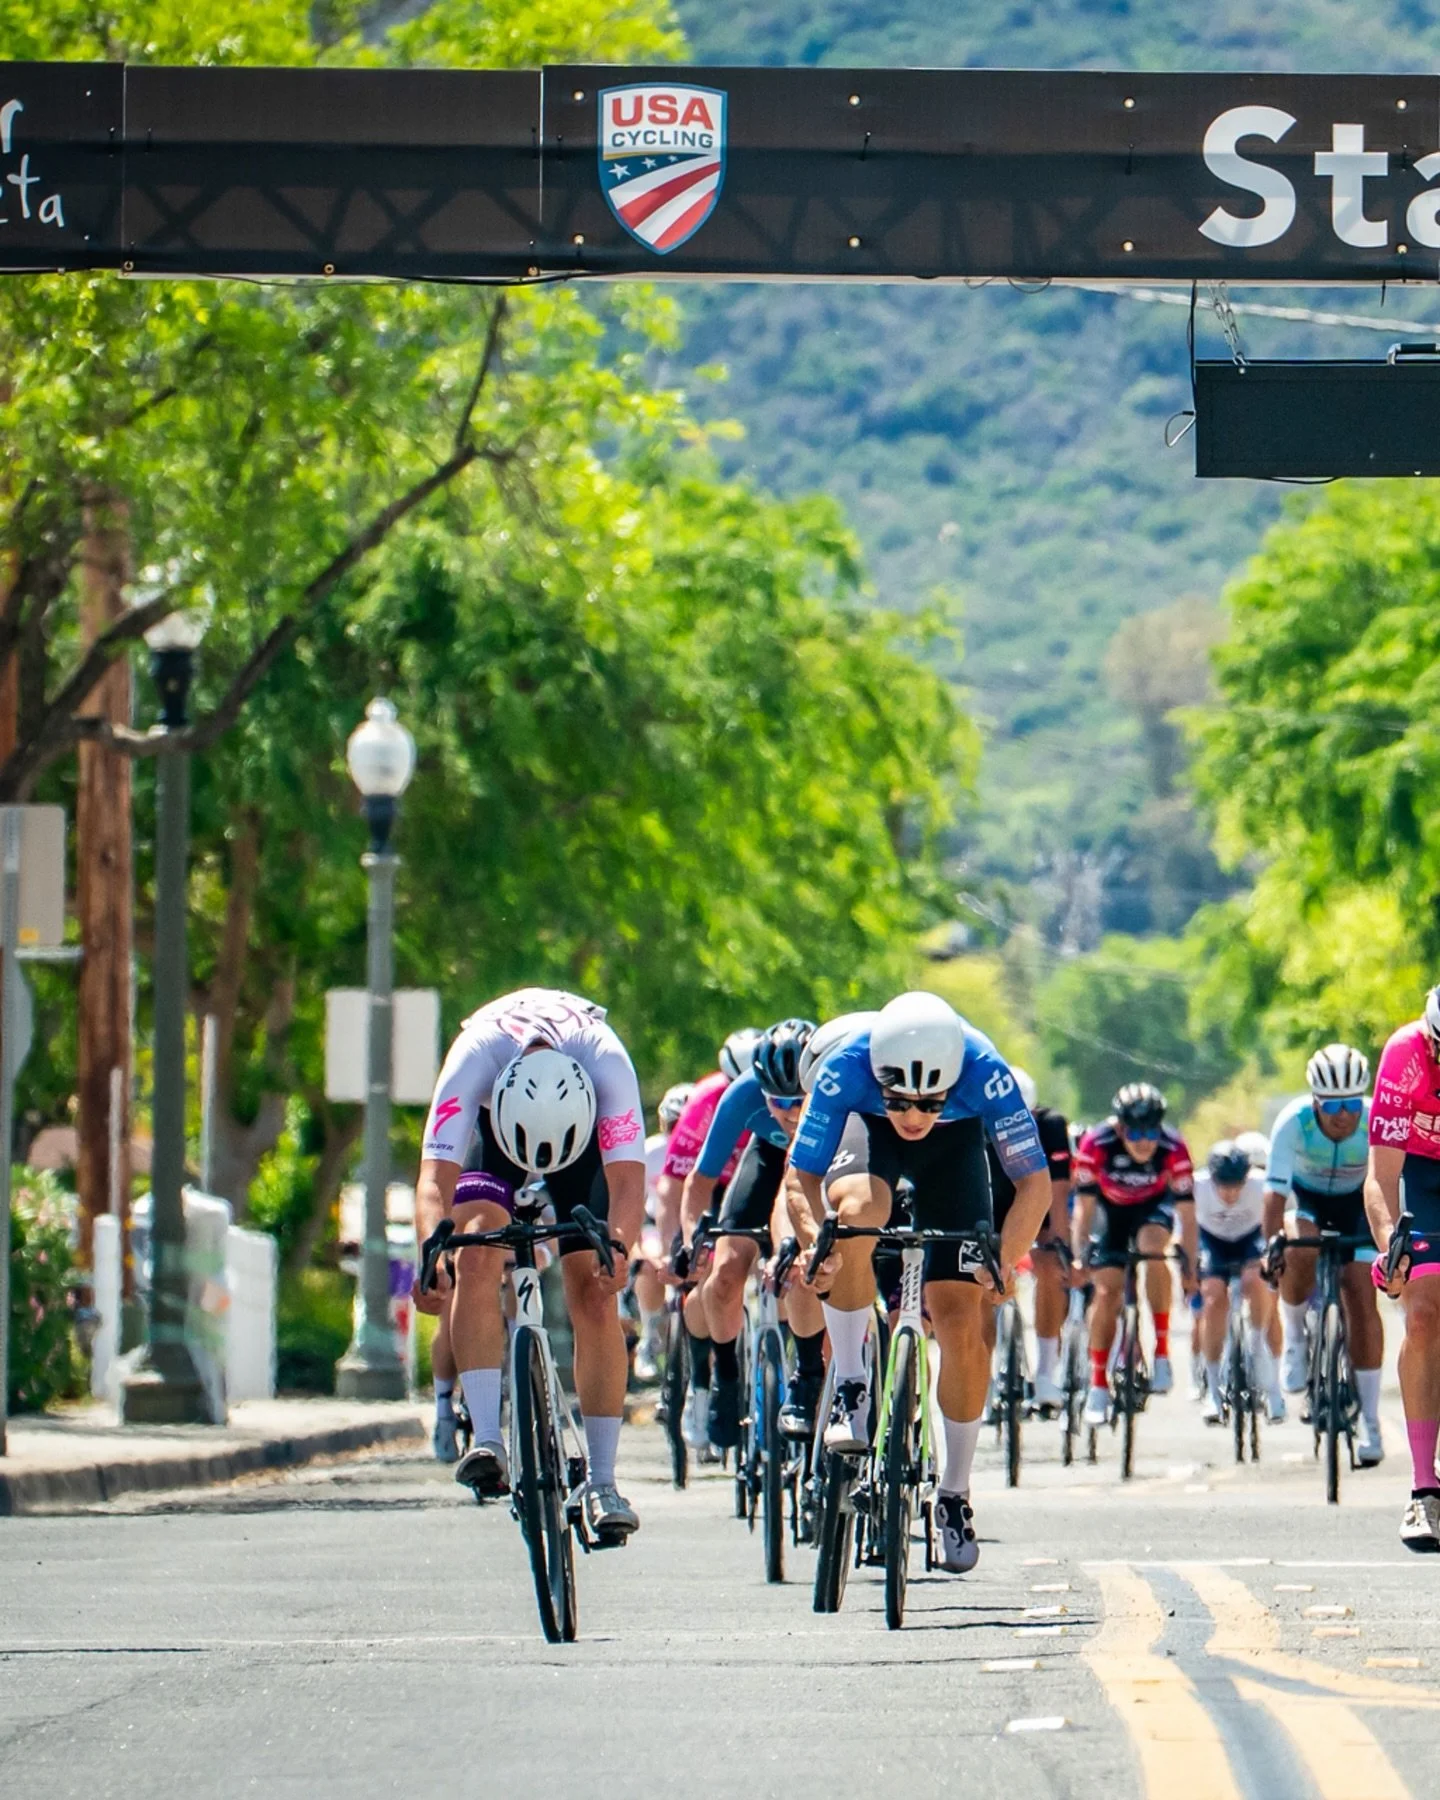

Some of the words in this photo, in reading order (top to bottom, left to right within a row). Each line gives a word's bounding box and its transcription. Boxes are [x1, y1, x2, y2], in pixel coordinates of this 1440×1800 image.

[612, 94, 713, 130] USA
[611, 130, 714, 148] CYCLING
[0, 153, 65, 227] ta
